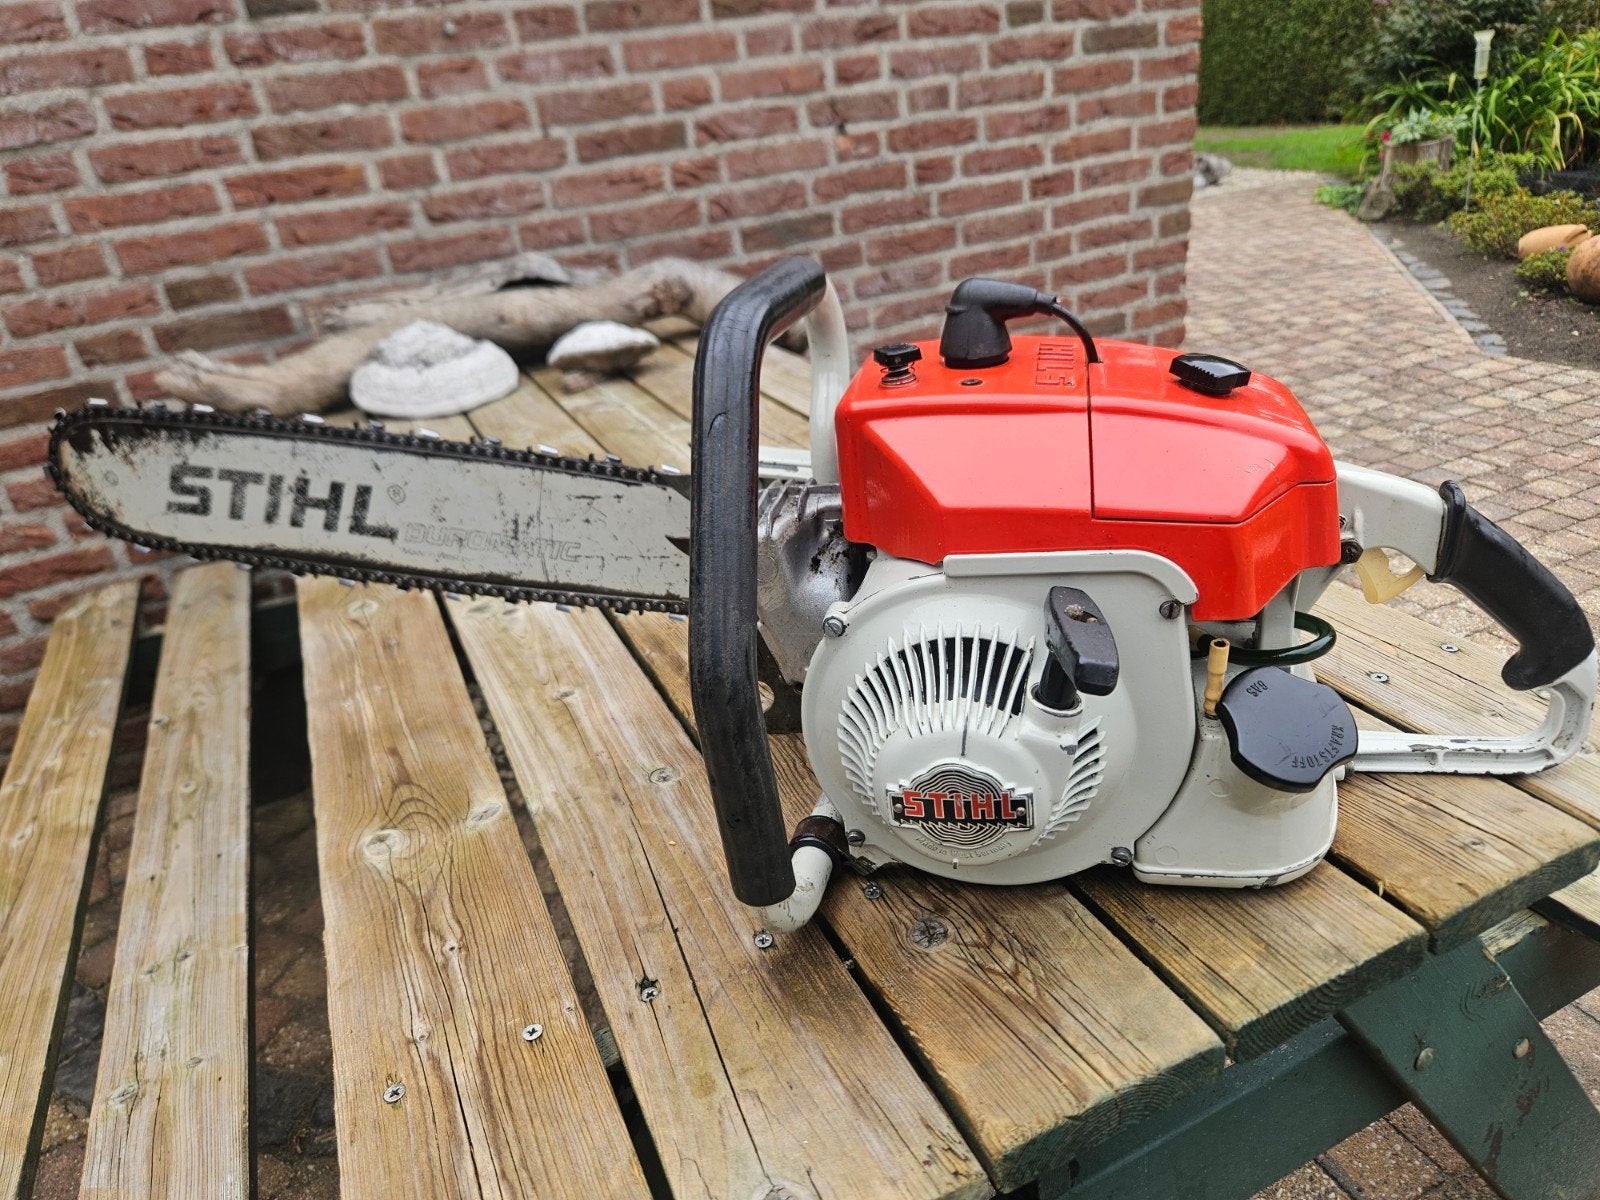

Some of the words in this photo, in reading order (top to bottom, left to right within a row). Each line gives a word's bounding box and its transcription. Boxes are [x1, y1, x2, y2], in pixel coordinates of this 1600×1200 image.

[167, 464, 398, 541] STIHL
[1246, 680, 1269, 697] GAS
[1291, 725, 1345, 769] KRAFTSTOFF
[903, 789, 1018, 819] STIHL
